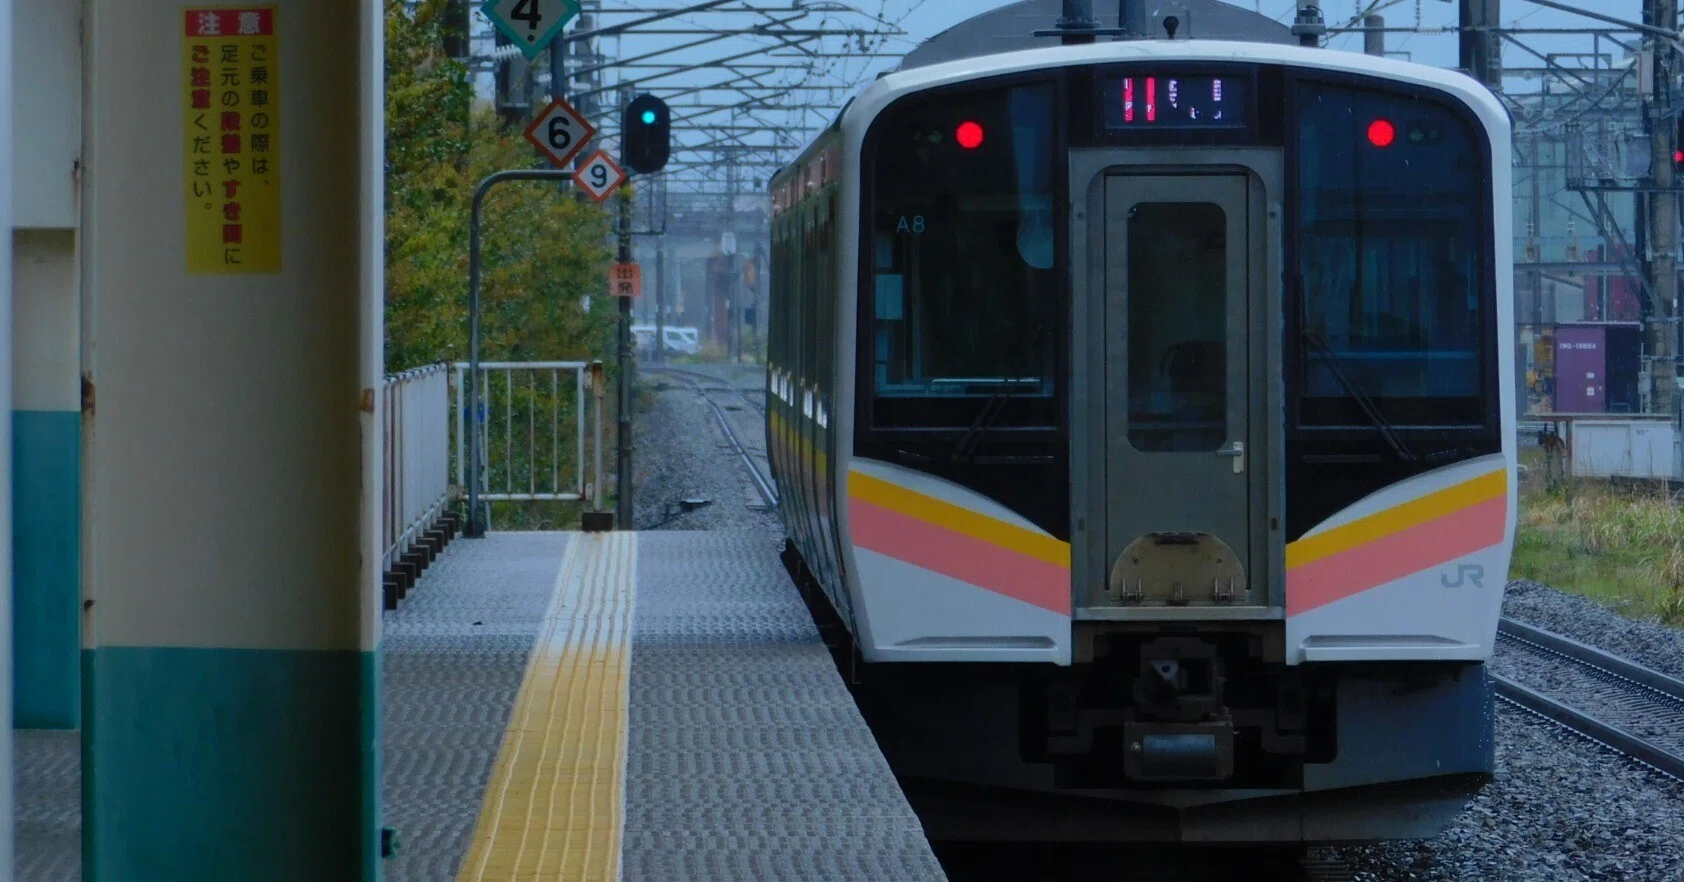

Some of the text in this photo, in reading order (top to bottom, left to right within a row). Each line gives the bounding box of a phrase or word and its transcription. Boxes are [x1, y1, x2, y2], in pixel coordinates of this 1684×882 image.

[198, 12, 260, 35] 注意
[511, 0, 542, 30] 4
[250, 44, 270, 185] ご乗車の際は、
[548, 116, 571, 149] 6
[590, 164, 608, 188] 9
[896, 215, 925, 233] A8
[616, 267, 634, 294] 出発
[1441, 564, 1484, 588] JR
